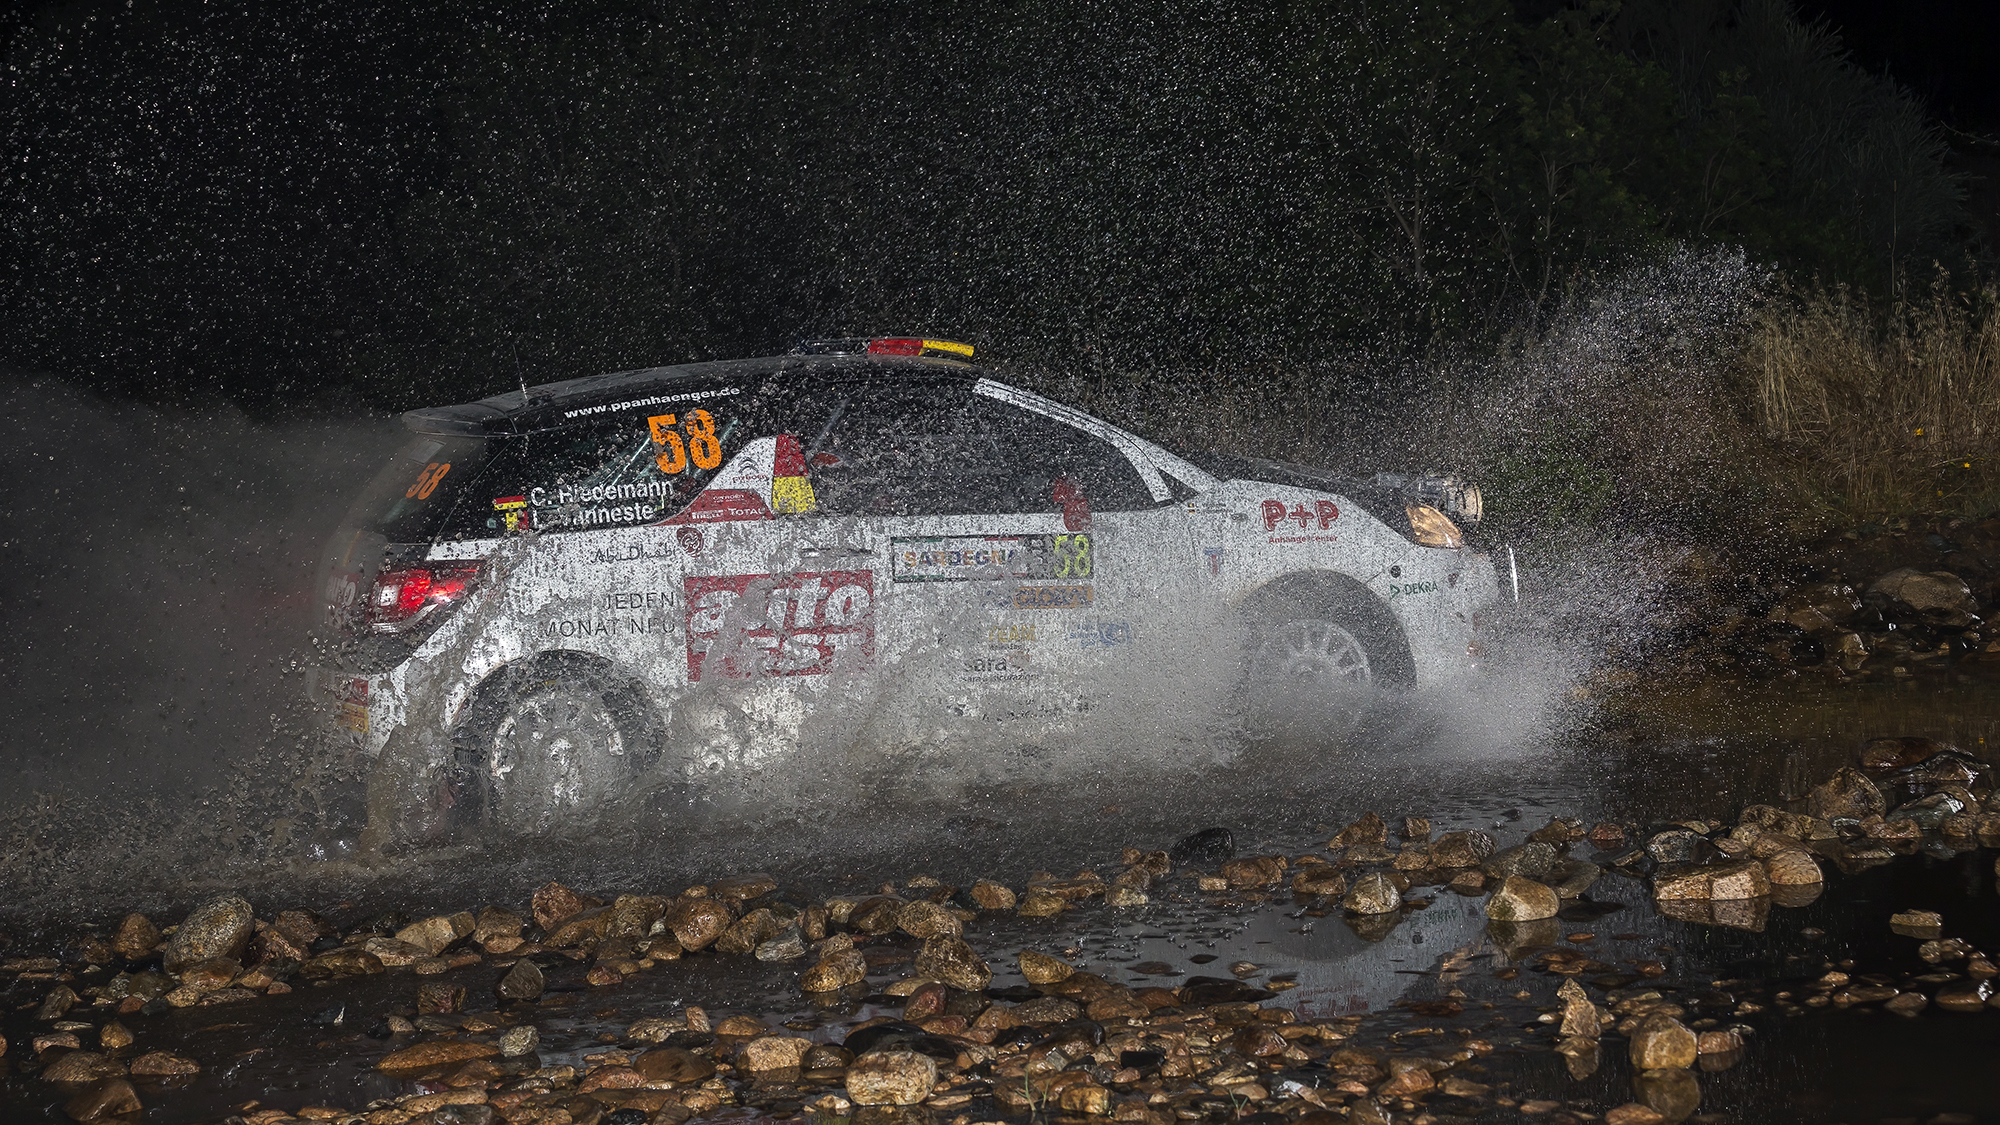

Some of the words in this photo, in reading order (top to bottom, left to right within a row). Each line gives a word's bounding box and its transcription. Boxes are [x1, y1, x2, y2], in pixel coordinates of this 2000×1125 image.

[564, 387, 740, 419] www.ppanhaenger.de
[648, 409, 722, 474] 58
[405, 463, 450, 500] 58
[728, 507, 767, 516] TOTAL
[1261, 500, 1339, 532] P+P
[1054, 535, 1090, 578] 58
[1405, 581, 1439, 596] DEKRA
